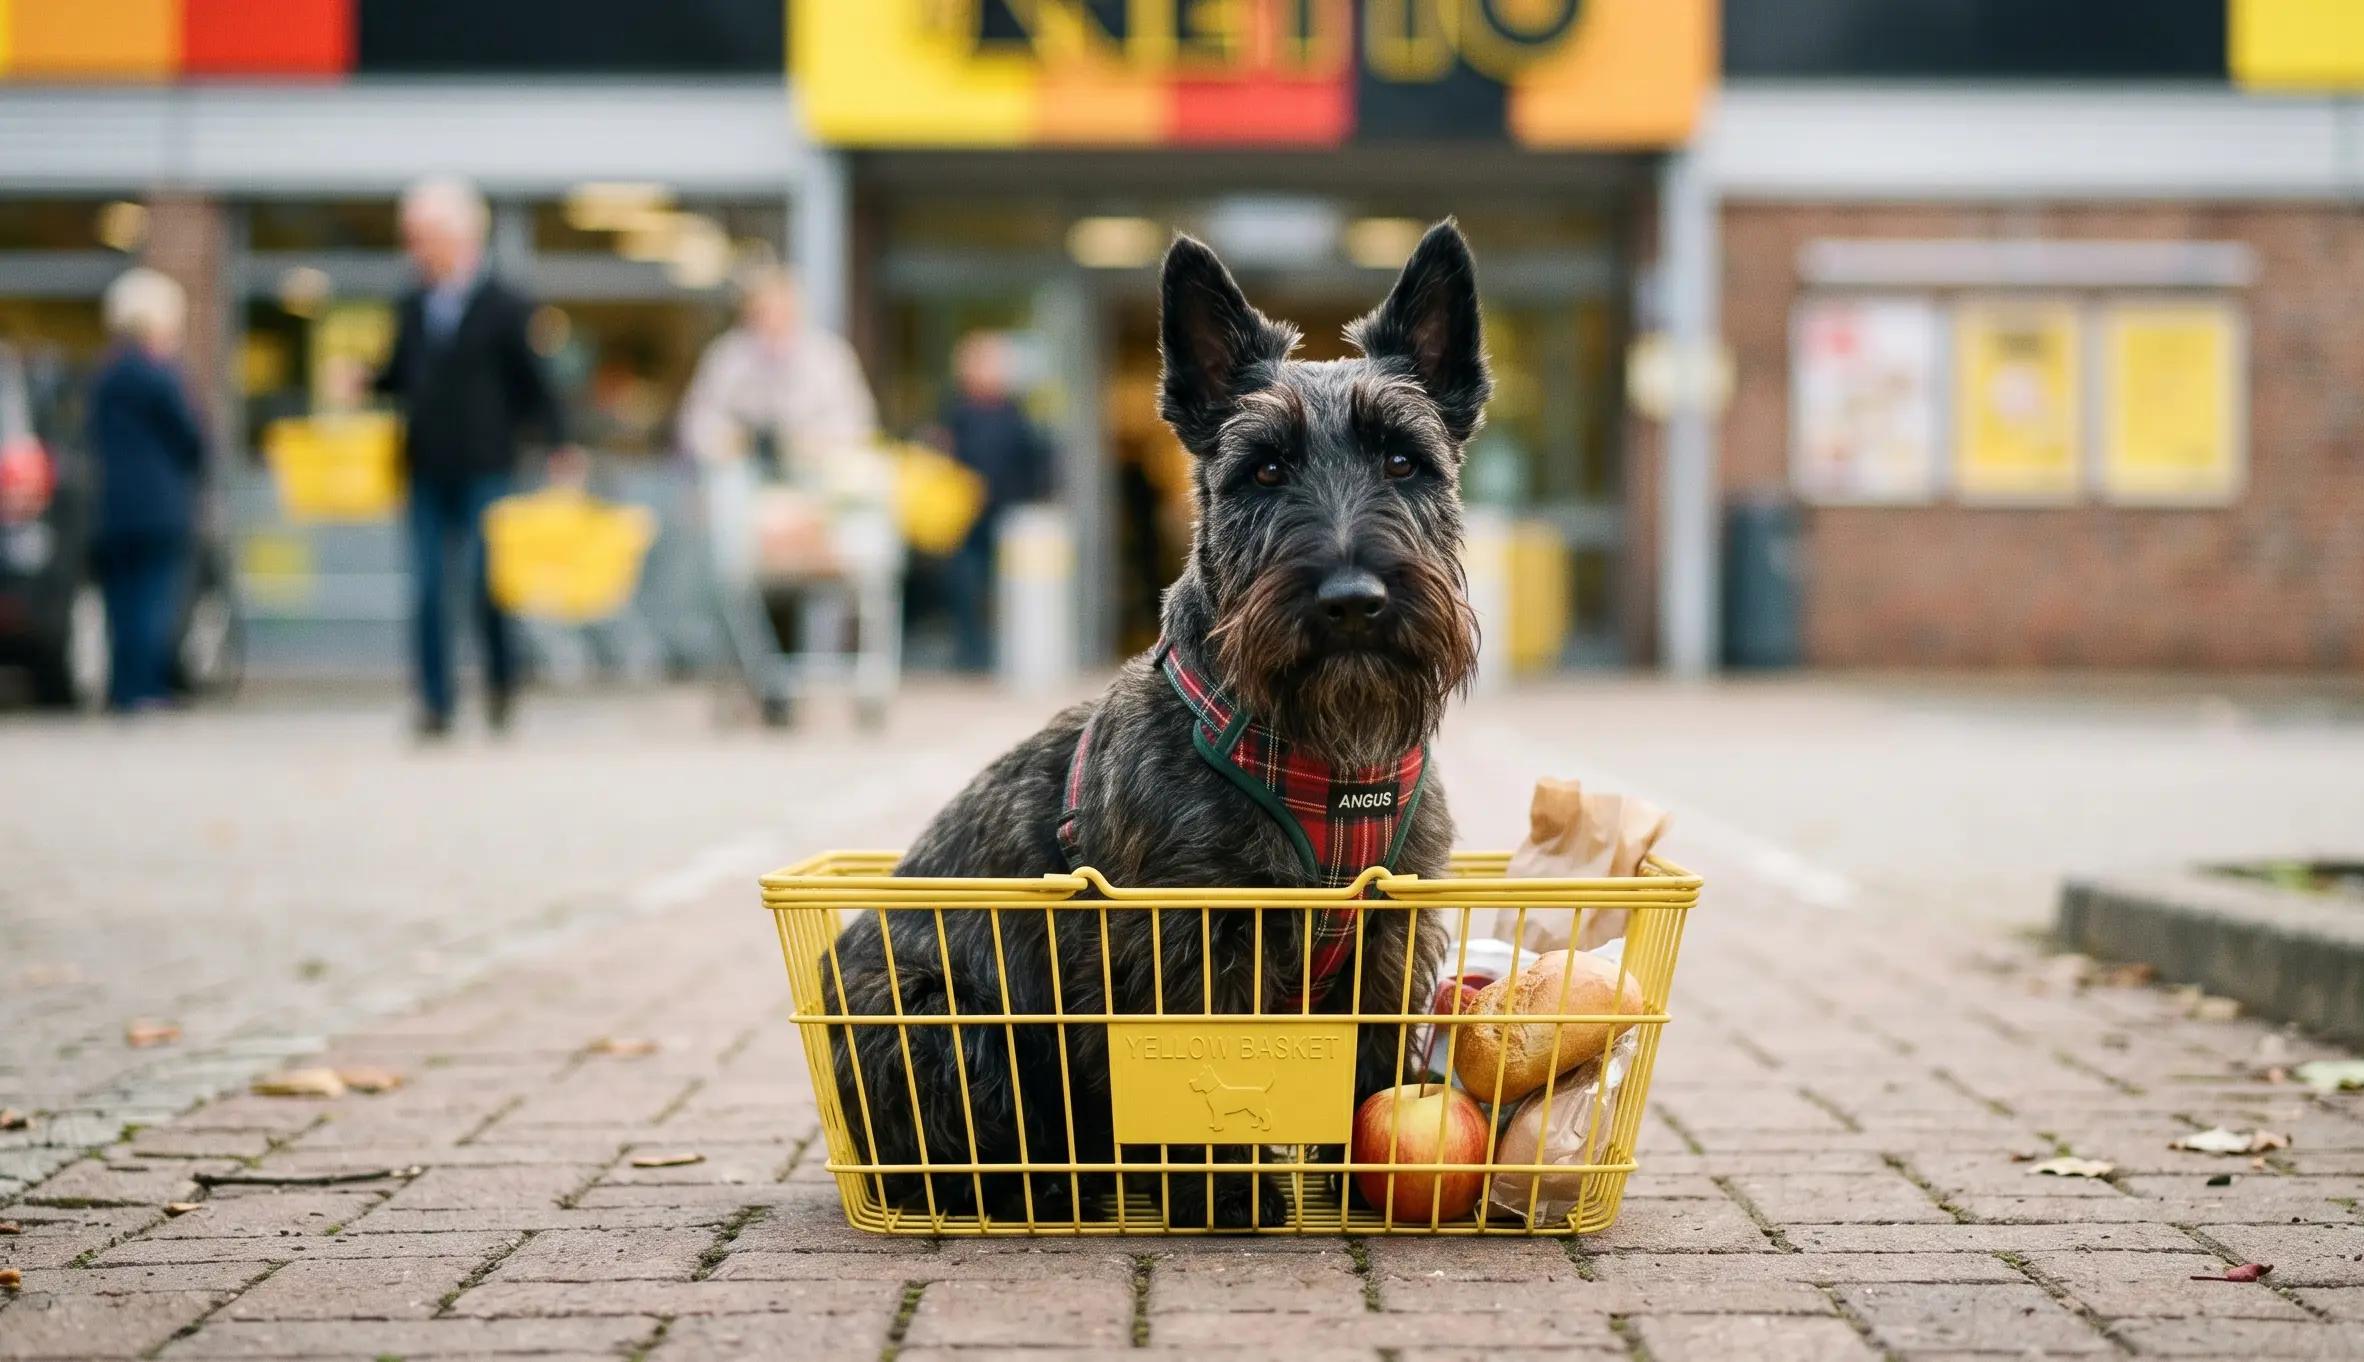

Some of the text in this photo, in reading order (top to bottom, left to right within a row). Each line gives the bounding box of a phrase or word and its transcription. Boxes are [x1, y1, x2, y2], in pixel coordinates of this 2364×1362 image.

[1338, 791, 1392, 809] ANGUS
[1125, 1035, 1339, 1060] YELLOW BASKET
